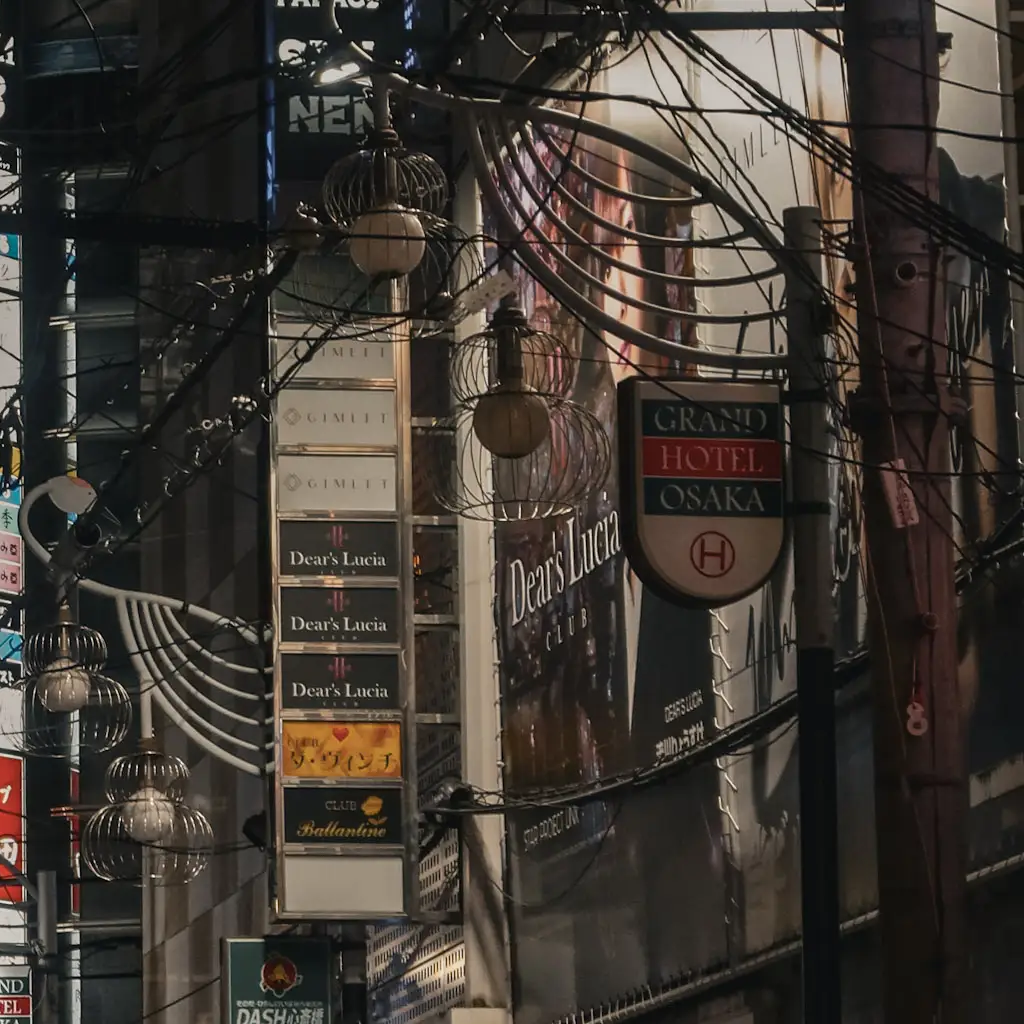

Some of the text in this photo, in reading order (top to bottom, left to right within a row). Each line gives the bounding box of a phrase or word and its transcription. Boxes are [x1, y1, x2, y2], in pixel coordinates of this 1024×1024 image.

[653, 404, 768, 433] GRAND
[659, 444, 764, 473] HOTEL
[659, 483, 766, 513] OSAKA
[289, 550, 387, 567] Dear's Lucia
[509, 509, 623, 628] Dear's Lucia
[290, 615, 388, 633] Dear's Lucia
[545, 605, 589, 652] CLUB
[291, 681, 389, 699] Dear's Lucia
[325, 800, 357, 811] CLUB
[296, 819, 388, 838] Ballantine
